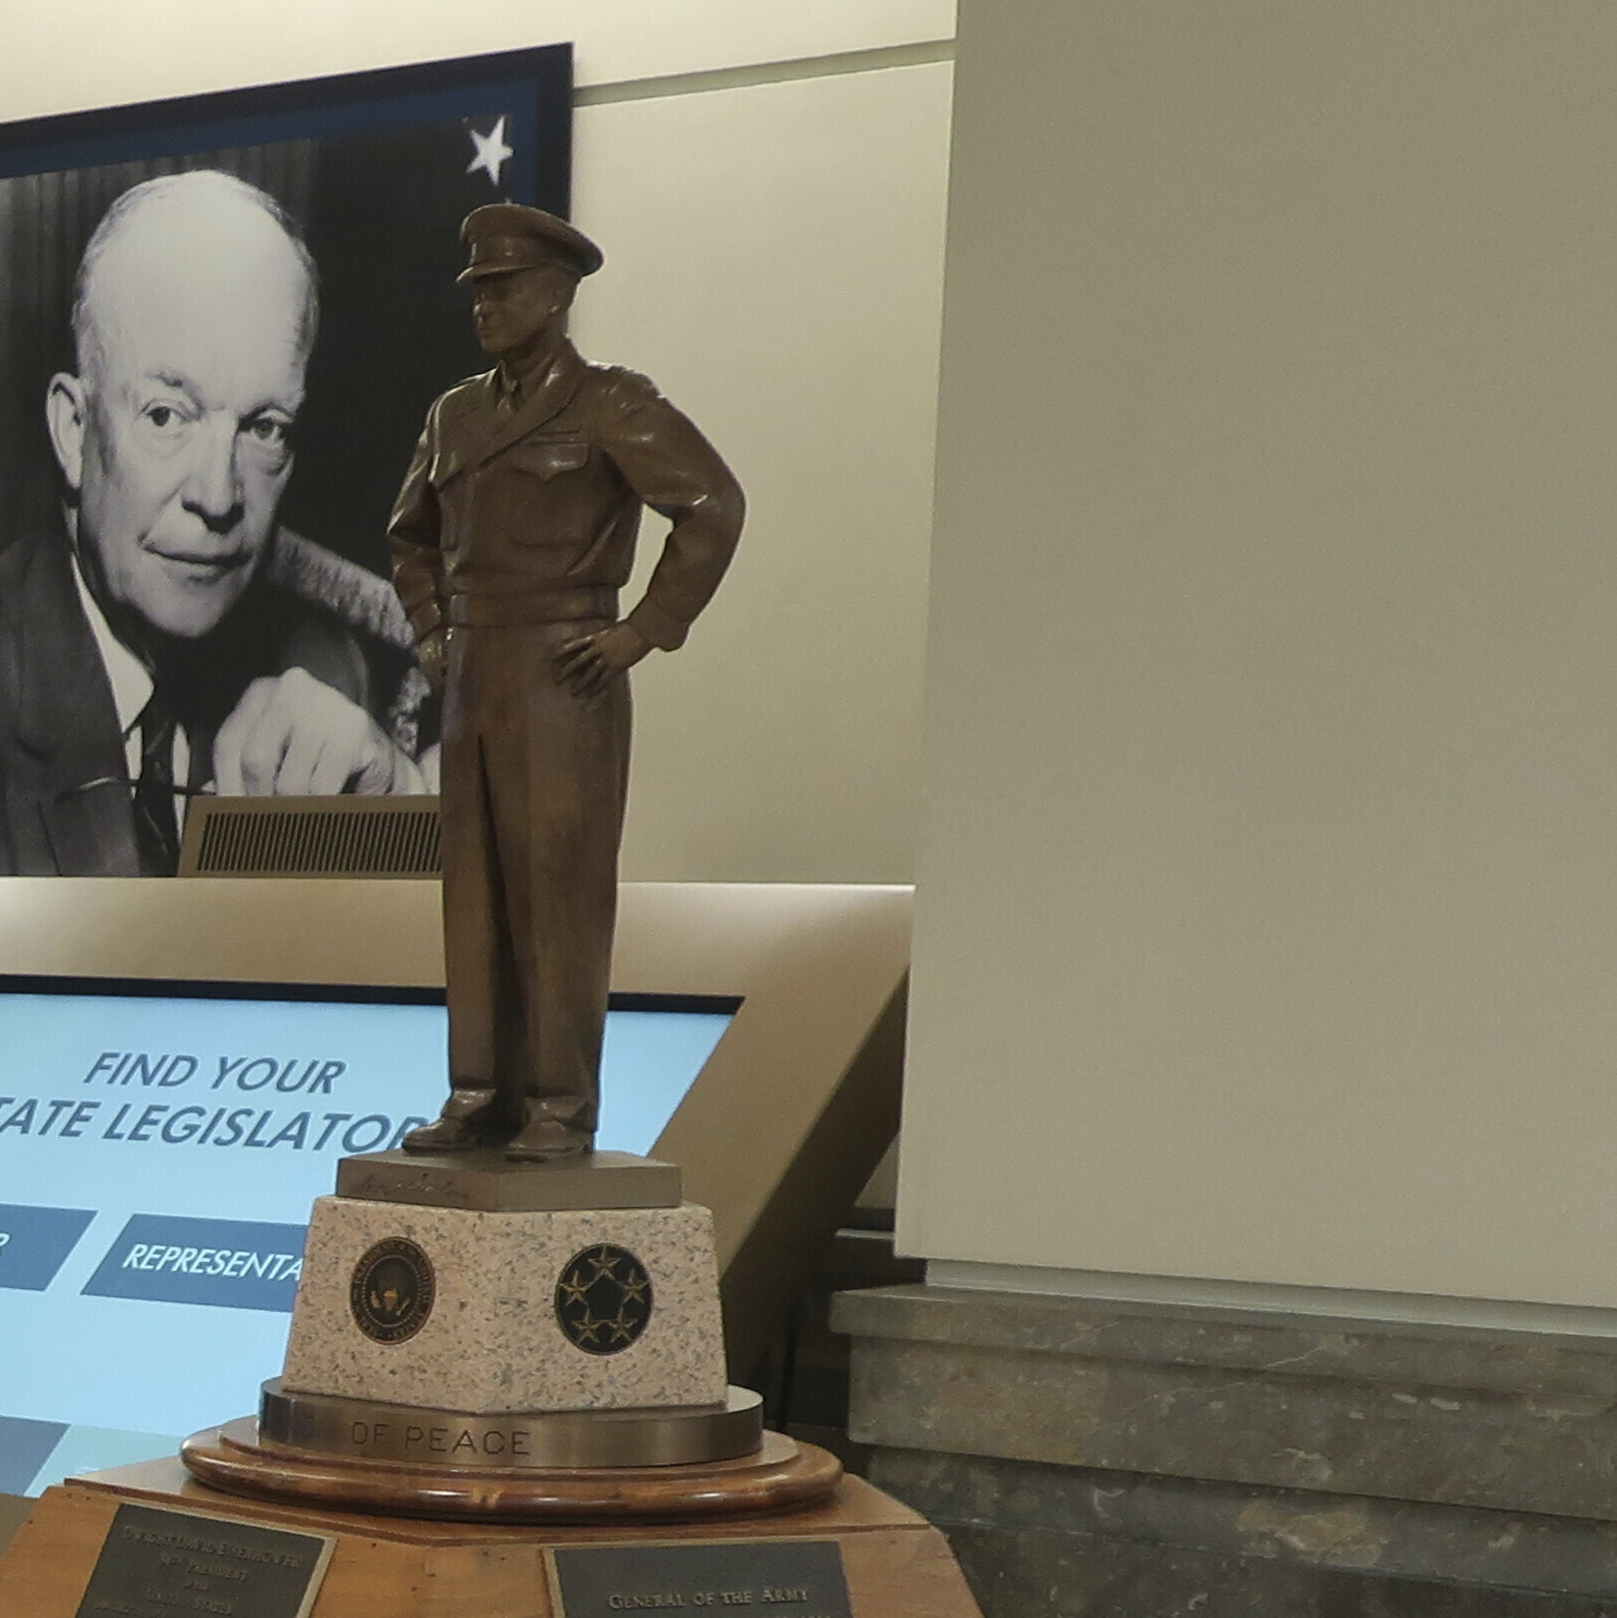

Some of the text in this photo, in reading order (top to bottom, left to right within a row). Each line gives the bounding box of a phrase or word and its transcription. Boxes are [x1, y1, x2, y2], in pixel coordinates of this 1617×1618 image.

[82, 1052, 346, 1094] FIND YOUR
[351, 1421, 531, 1456] OF PEACE
[609, 1587, 809, 1610] GENERAL OF THE ARMY
